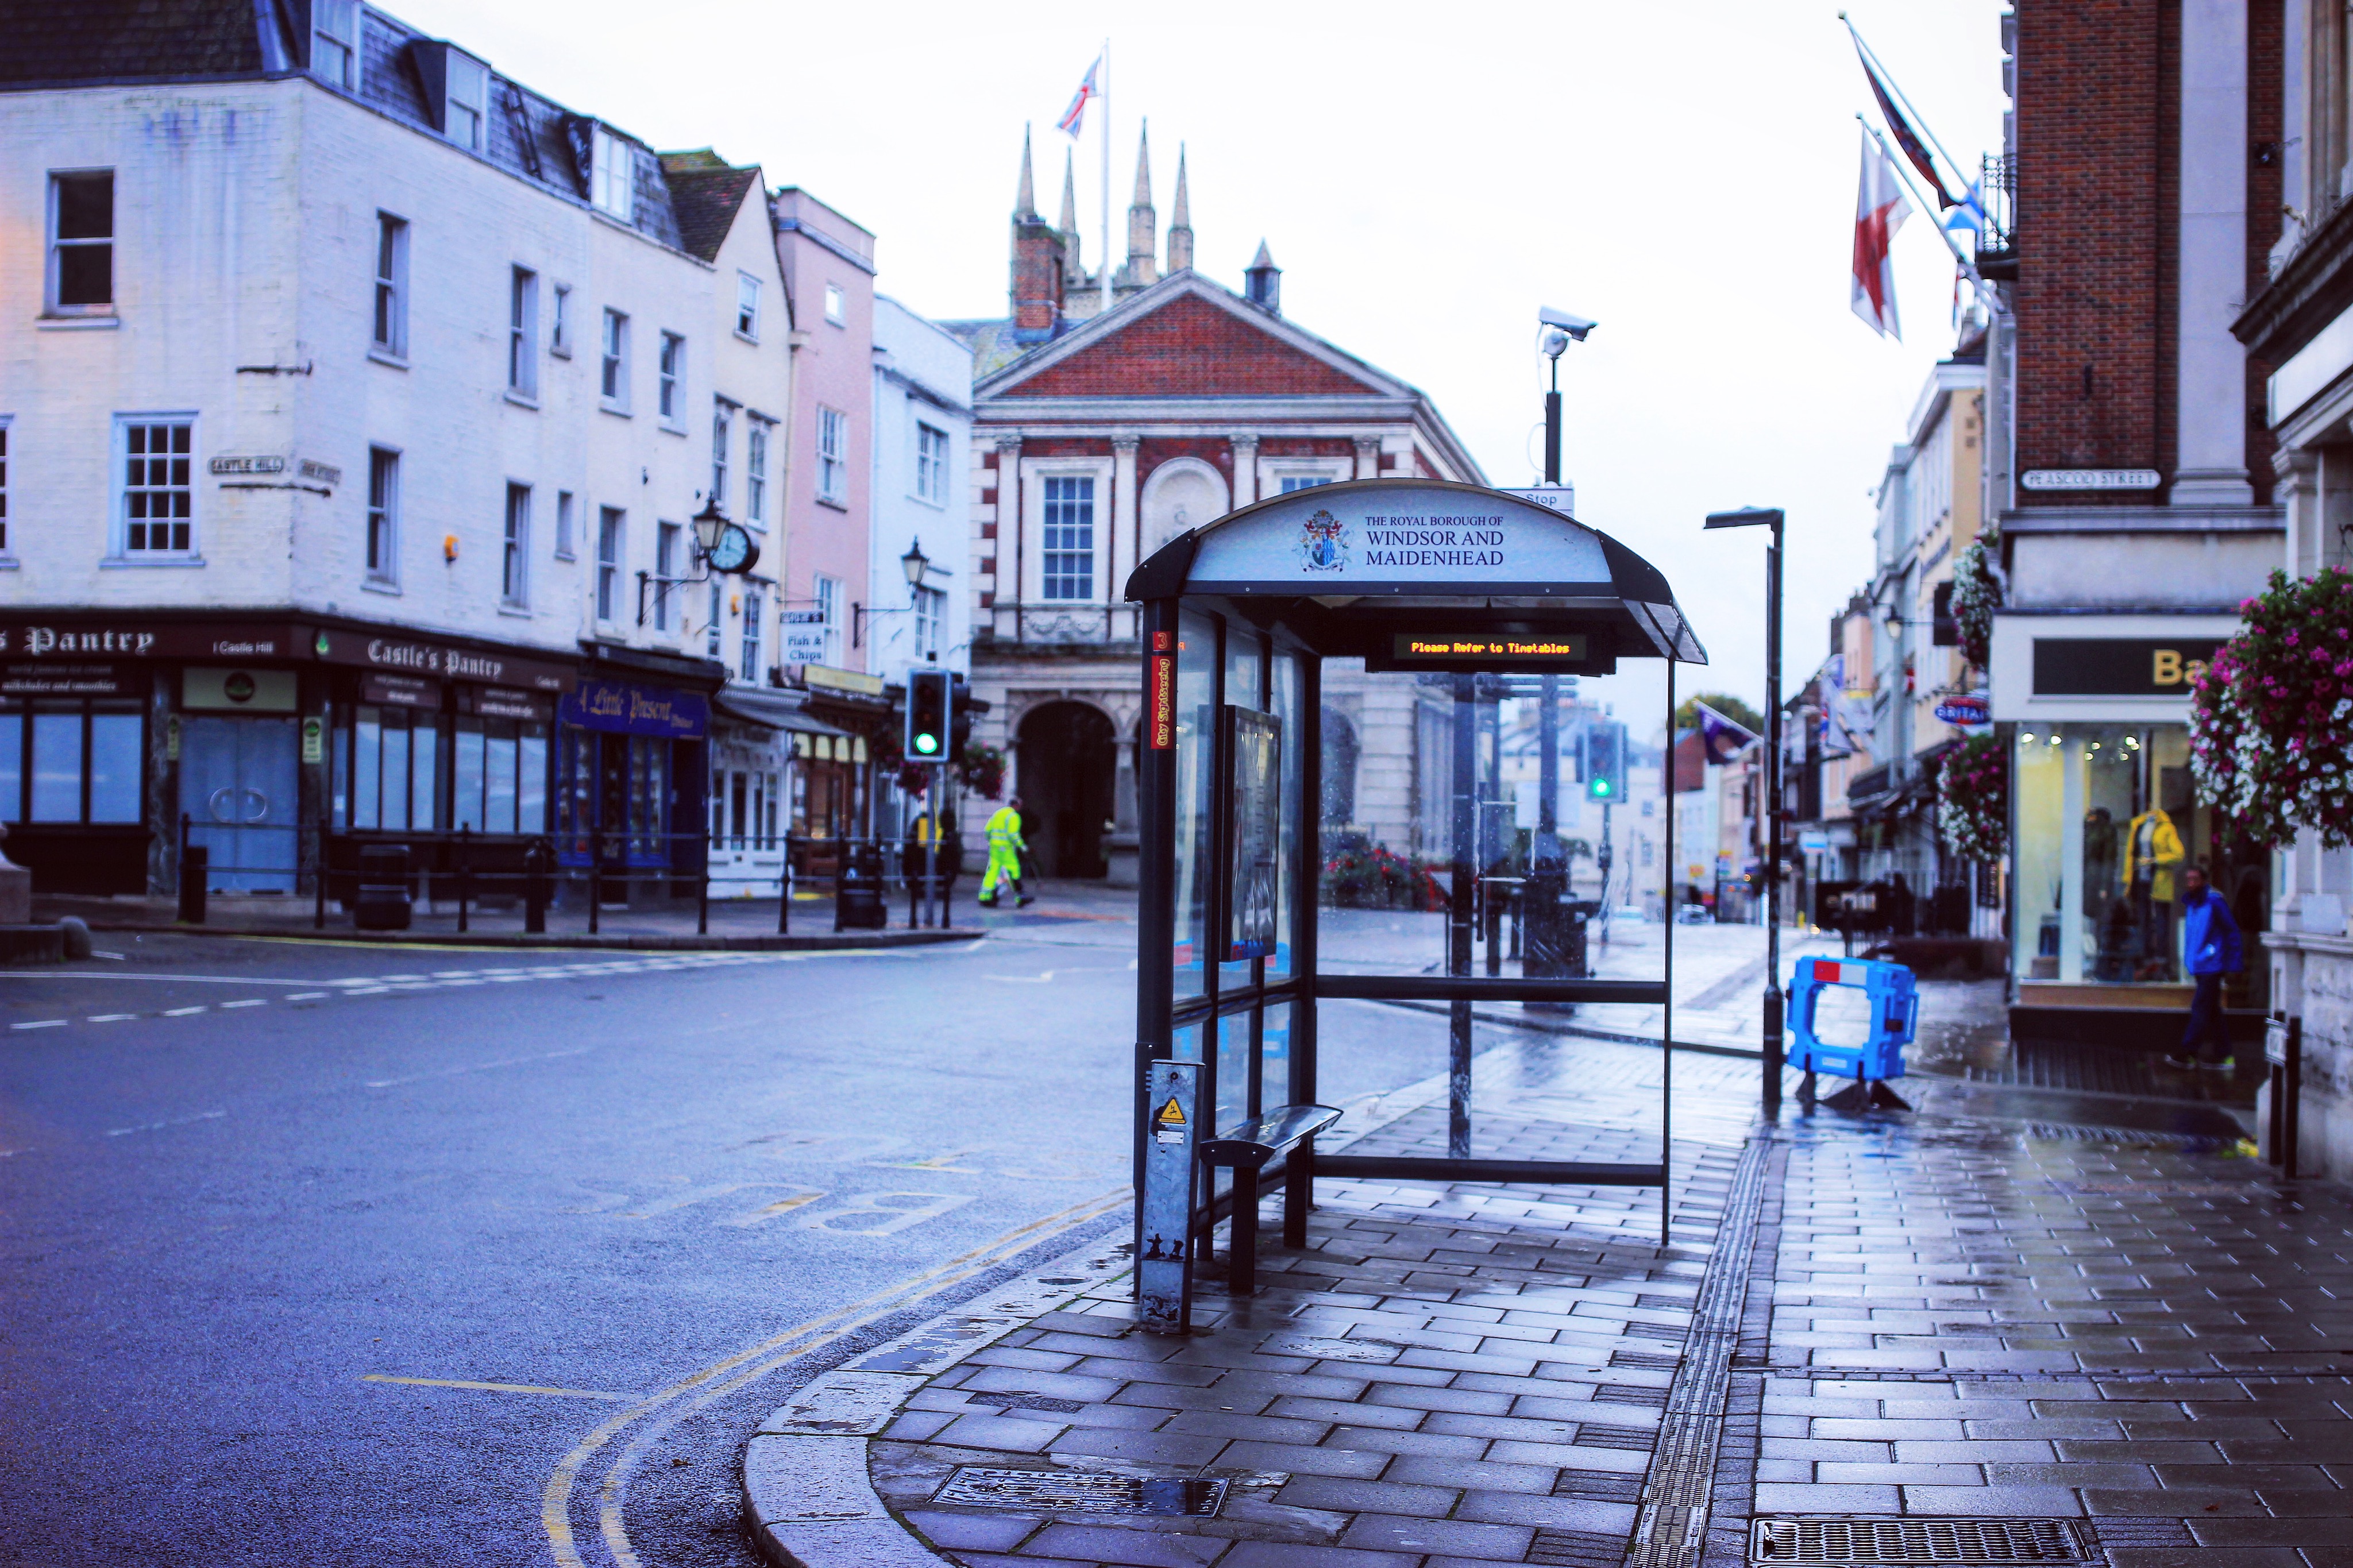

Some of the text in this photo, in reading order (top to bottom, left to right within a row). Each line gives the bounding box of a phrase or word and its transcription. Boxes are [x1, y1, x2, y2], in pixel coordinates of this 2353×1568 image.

[2029, 470, 2154, 484] PEASCOD STREET
[1526, 494, 1557, 505] Stop
[1365, 516, 1503, 526] THE ROYAL BOROUGH OF
[1367, 531, 1503, 546] WINDSOR AND
[1366, 551, 1503, 565] MAIDENHEAD
[24, 627, 155, 656] Pantry
[788, 635, 822, 646] Fish &
[1158, 632, 1167, 649] 3
[256, 642, 274, 655] Hill
[1411, 642, 1571, 654] Please Refer to Timetables
[368, 639, 504, 681] Castle's Pantry
[789, 650, 821, 662] Chips
[2154, 649, 2208, 685] Ba
[52, 679, 70, 691] and
[1157, 659, 1170, 746] City Sightseeing
[1936, 706, 1990, 720] BRITAI
